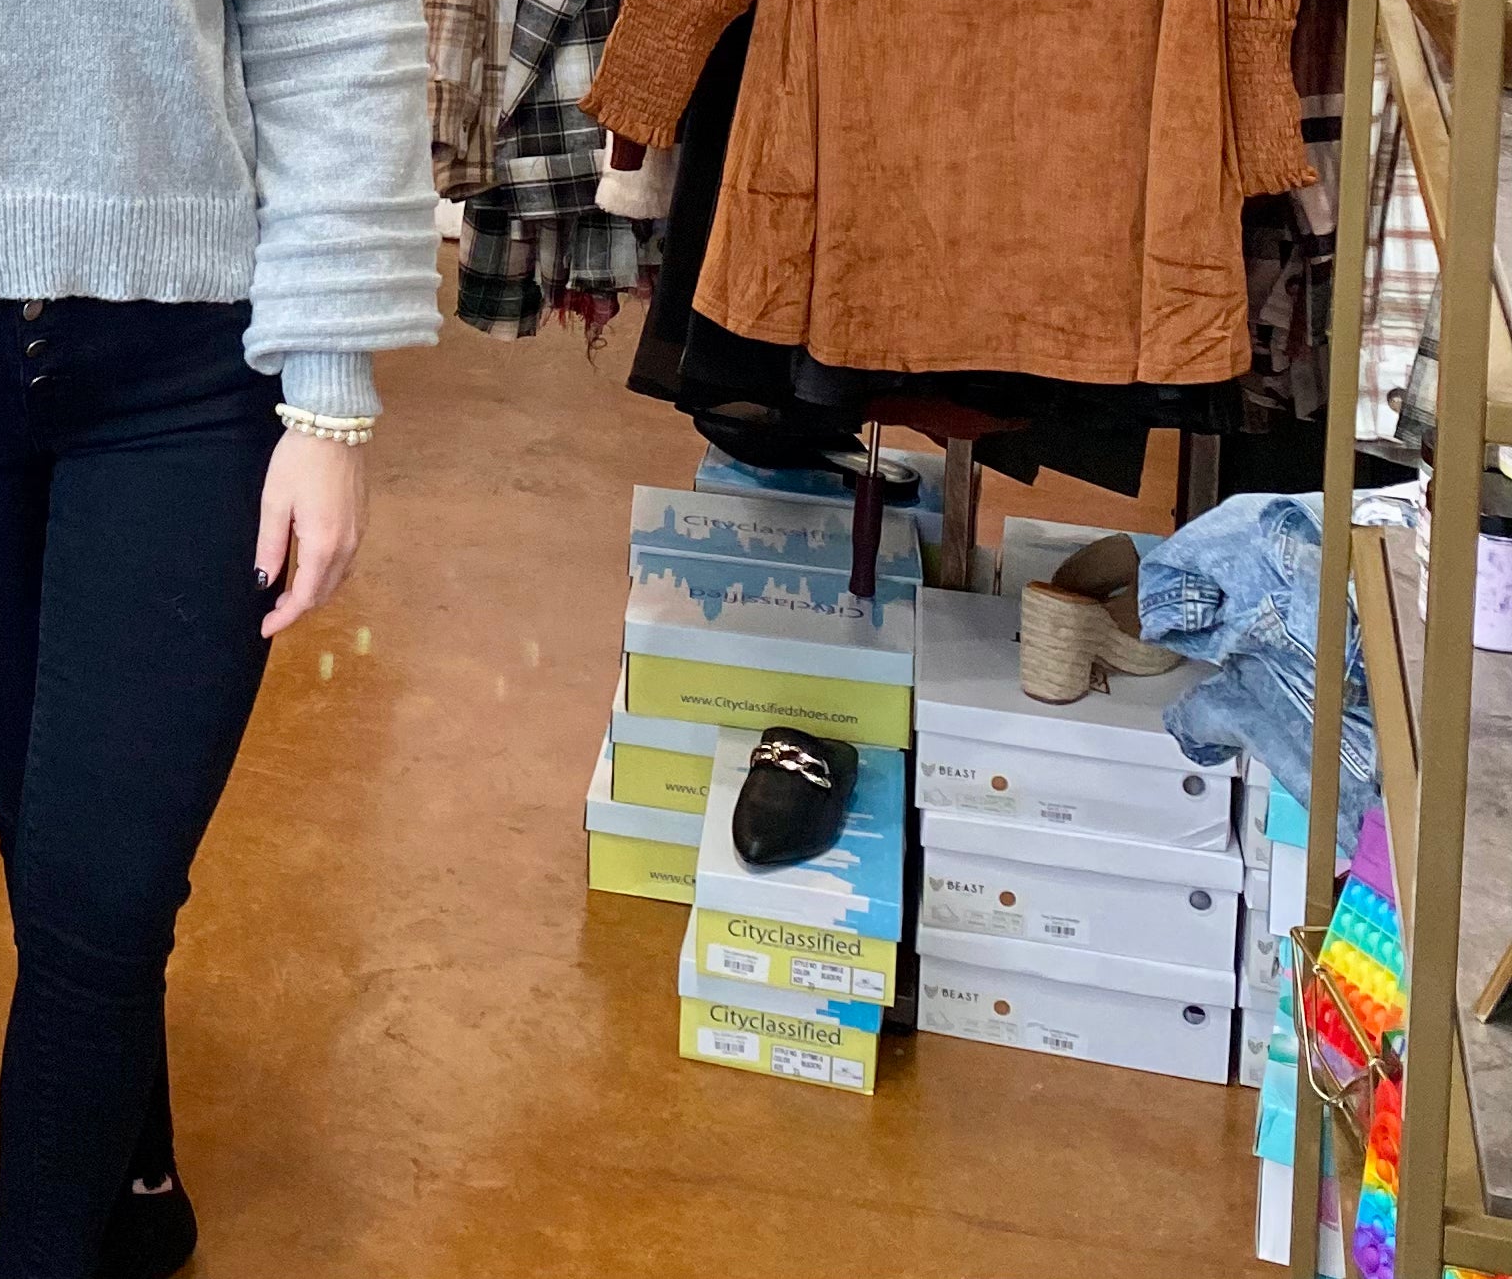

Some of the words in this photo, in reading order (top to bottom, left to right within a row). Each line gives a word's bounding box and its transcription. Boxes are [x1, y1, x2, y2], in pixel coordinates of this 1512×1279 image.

[680, 692, 859, 725] www.Cityclassifiedshoes.com
[939, 765, 977, 780] BEAST
[947, 880, 985, 895] BEAST
[727, 918, 862, 958] Cityclassified
[941, 987, 980, 1003] BEAST
[709, 1004, 842, 1047] Cityclassified
